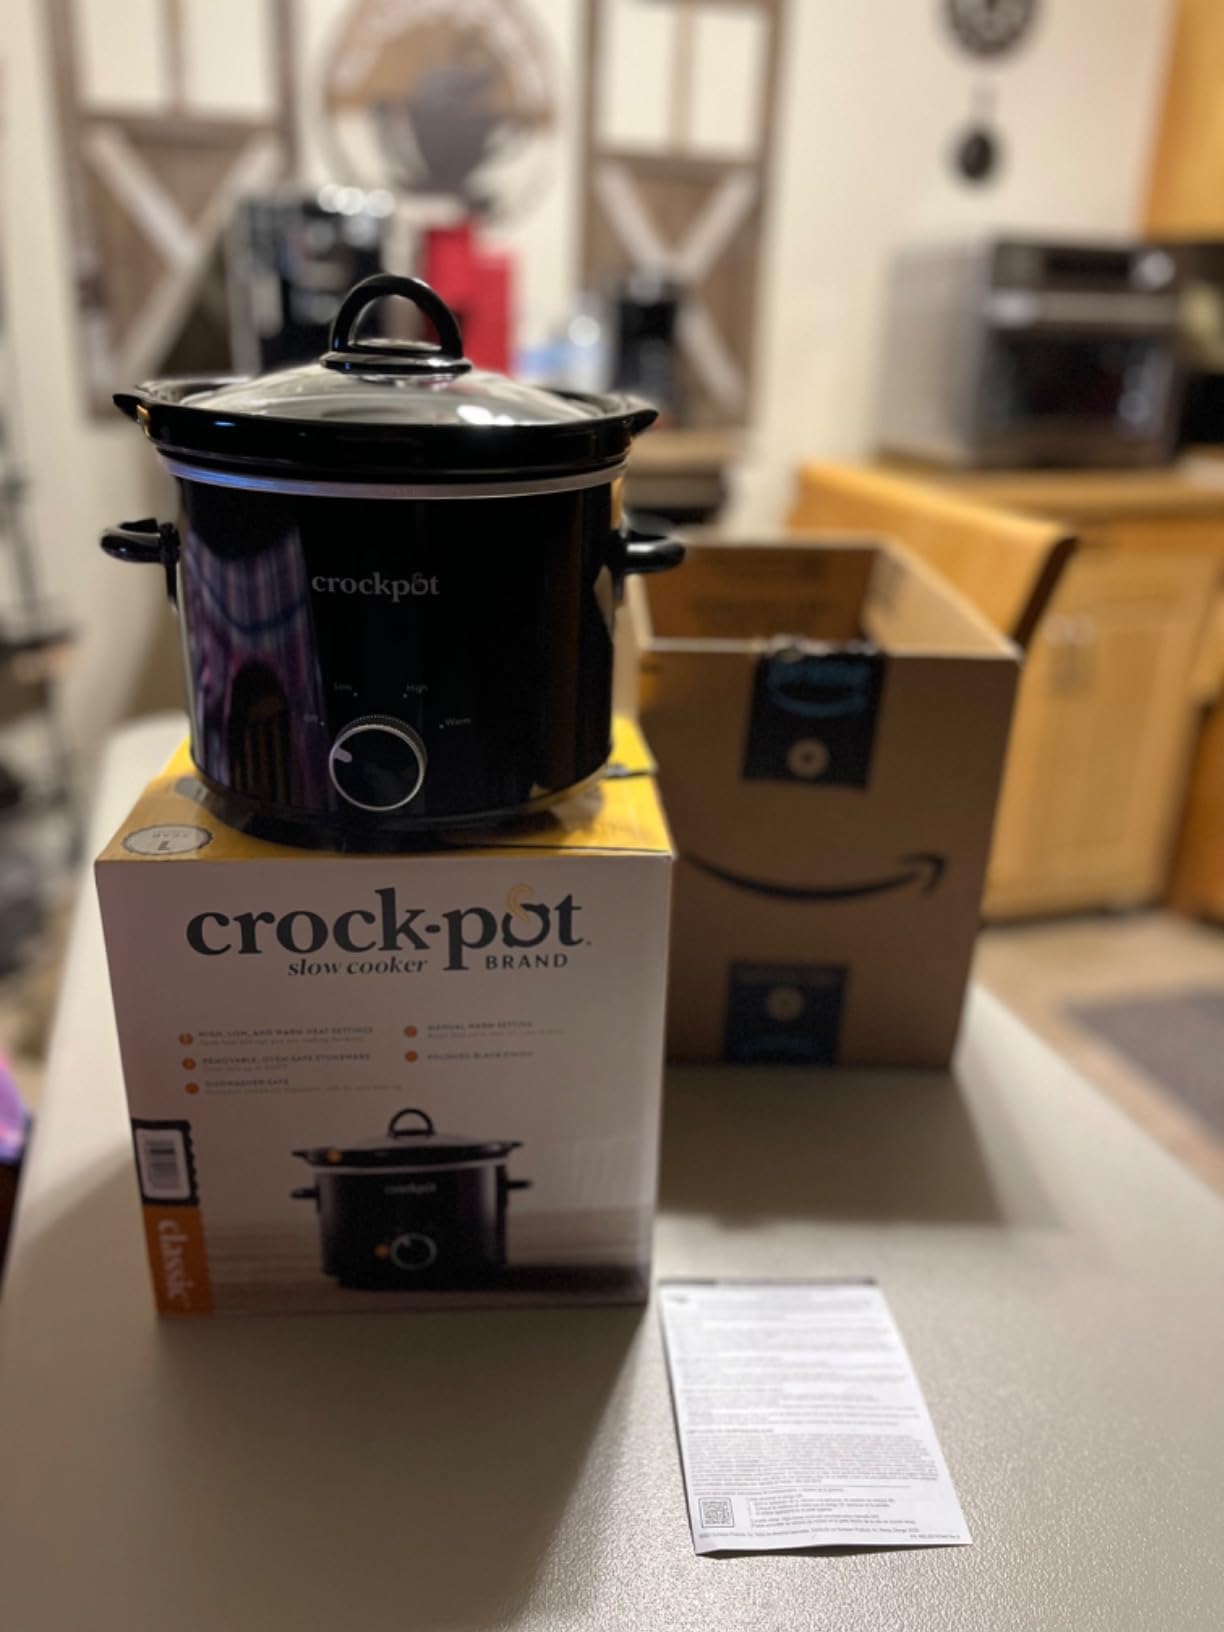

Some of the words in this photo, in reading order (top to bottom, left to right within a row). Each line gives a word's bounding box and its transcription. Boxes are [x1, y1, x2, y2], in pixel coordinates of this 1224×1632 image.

[312, 571, 440, 603] crockpot
[288, 958, 342, 976] slow
[347, 955, 428, 975] cooker
[486, 953, 568, 970] BRAND
[157, 1219, 196, 1300] classic
